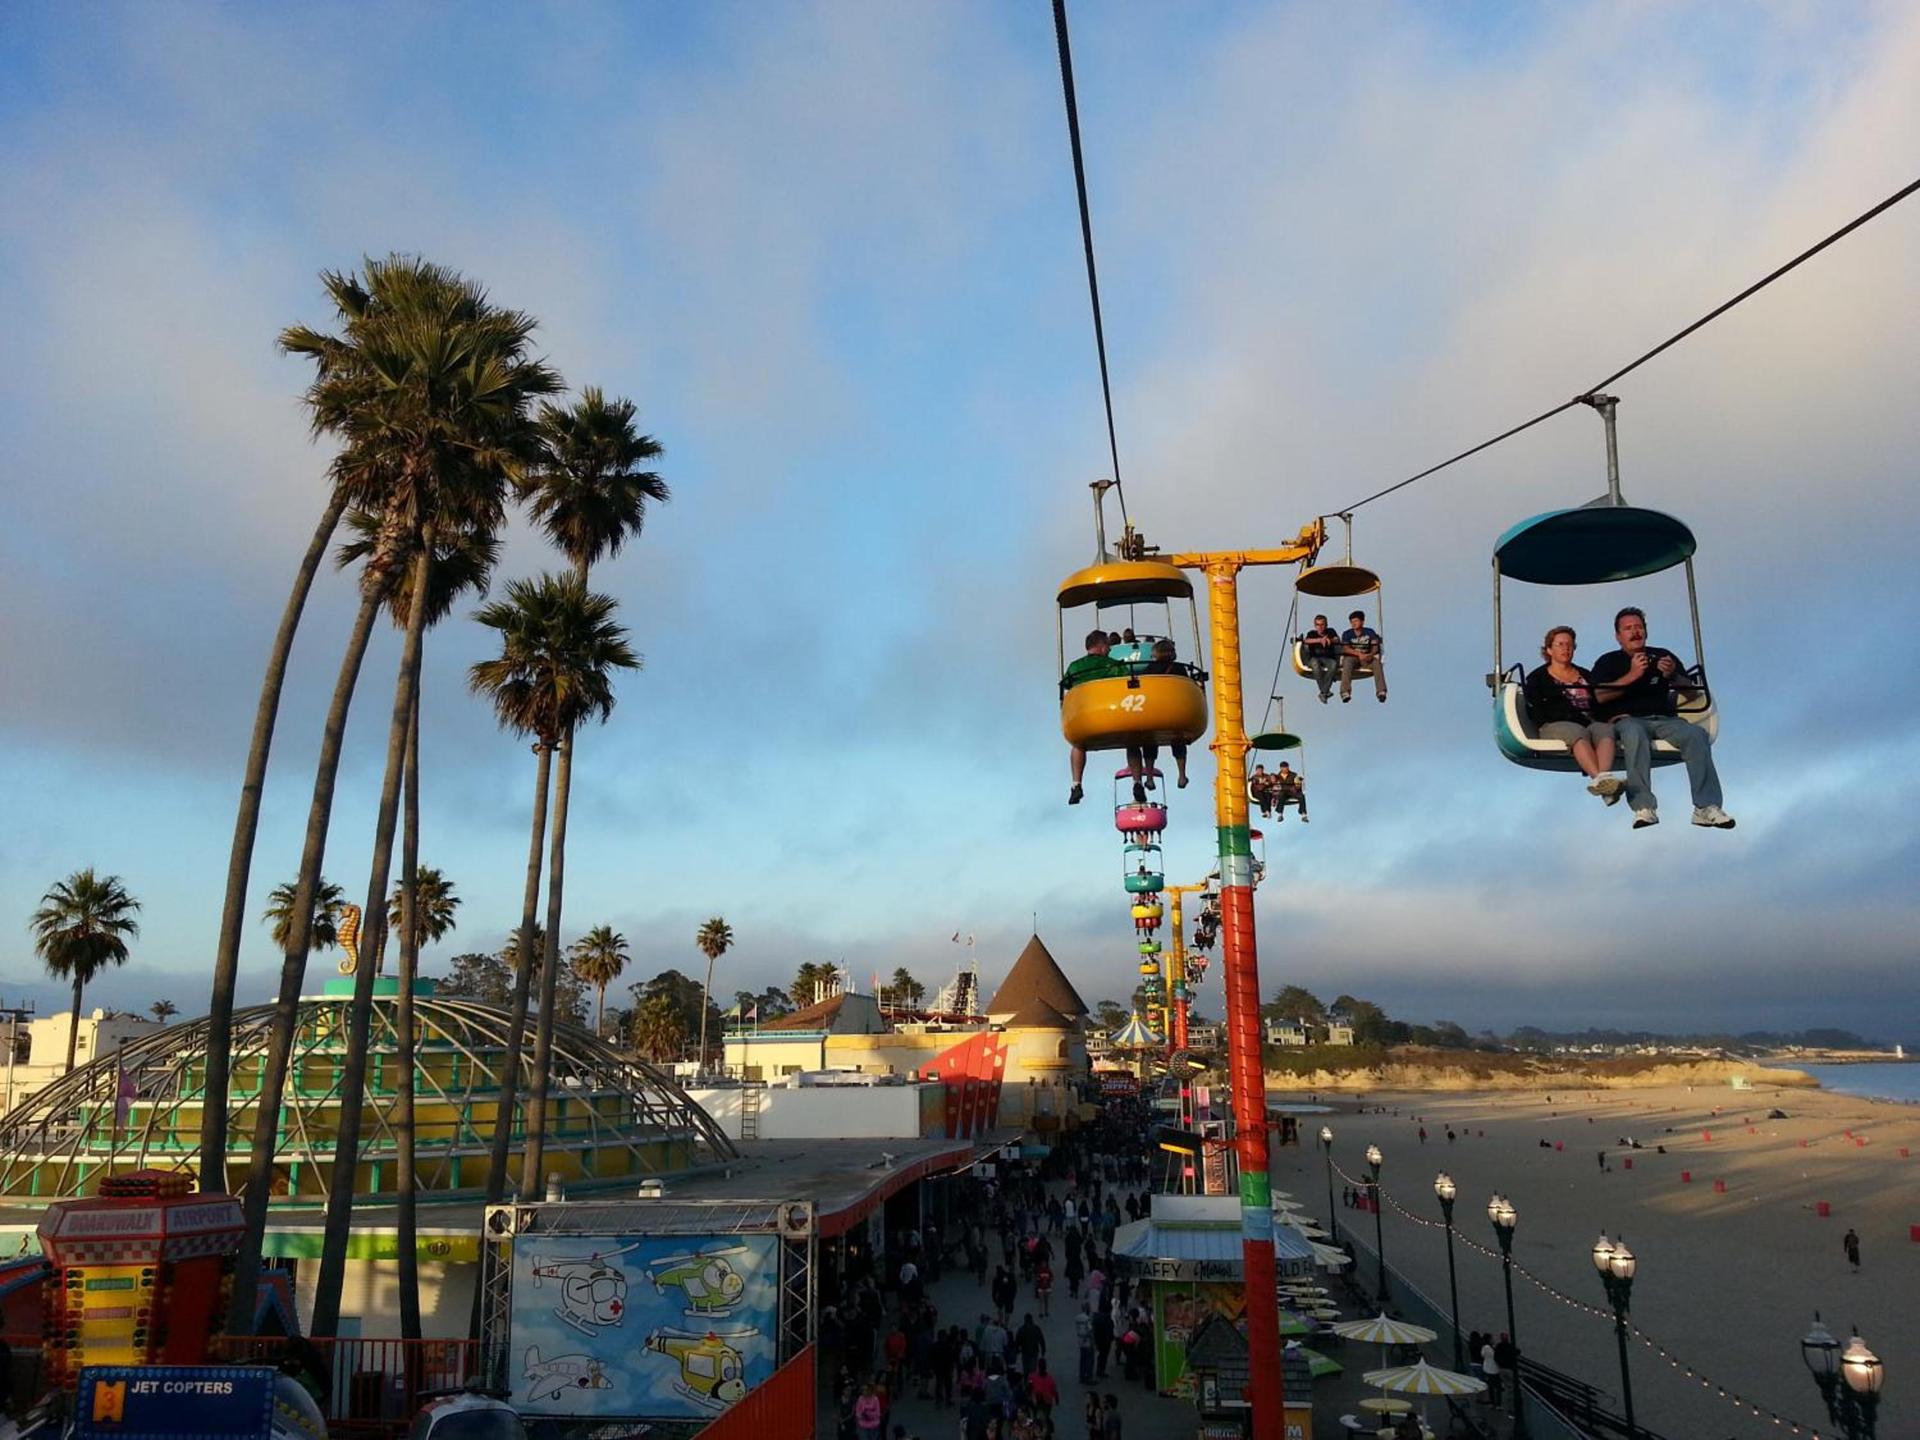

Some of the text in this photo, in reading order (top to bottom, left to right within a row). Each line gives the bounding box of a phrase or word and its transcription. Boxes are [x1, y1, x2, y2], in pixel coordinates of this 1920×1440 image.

[1129, 651, 1142, 662] 41
[1119, 694, 1146, 712] 42
[68, 1205, 233, 1232] BOARDWALK AIRPORT
[1135, 1261, 1182, 1278] TAFFY
[131, 1381, 233, 1394] JET COPTERS
[102, 1391, 114, 1411] 3
